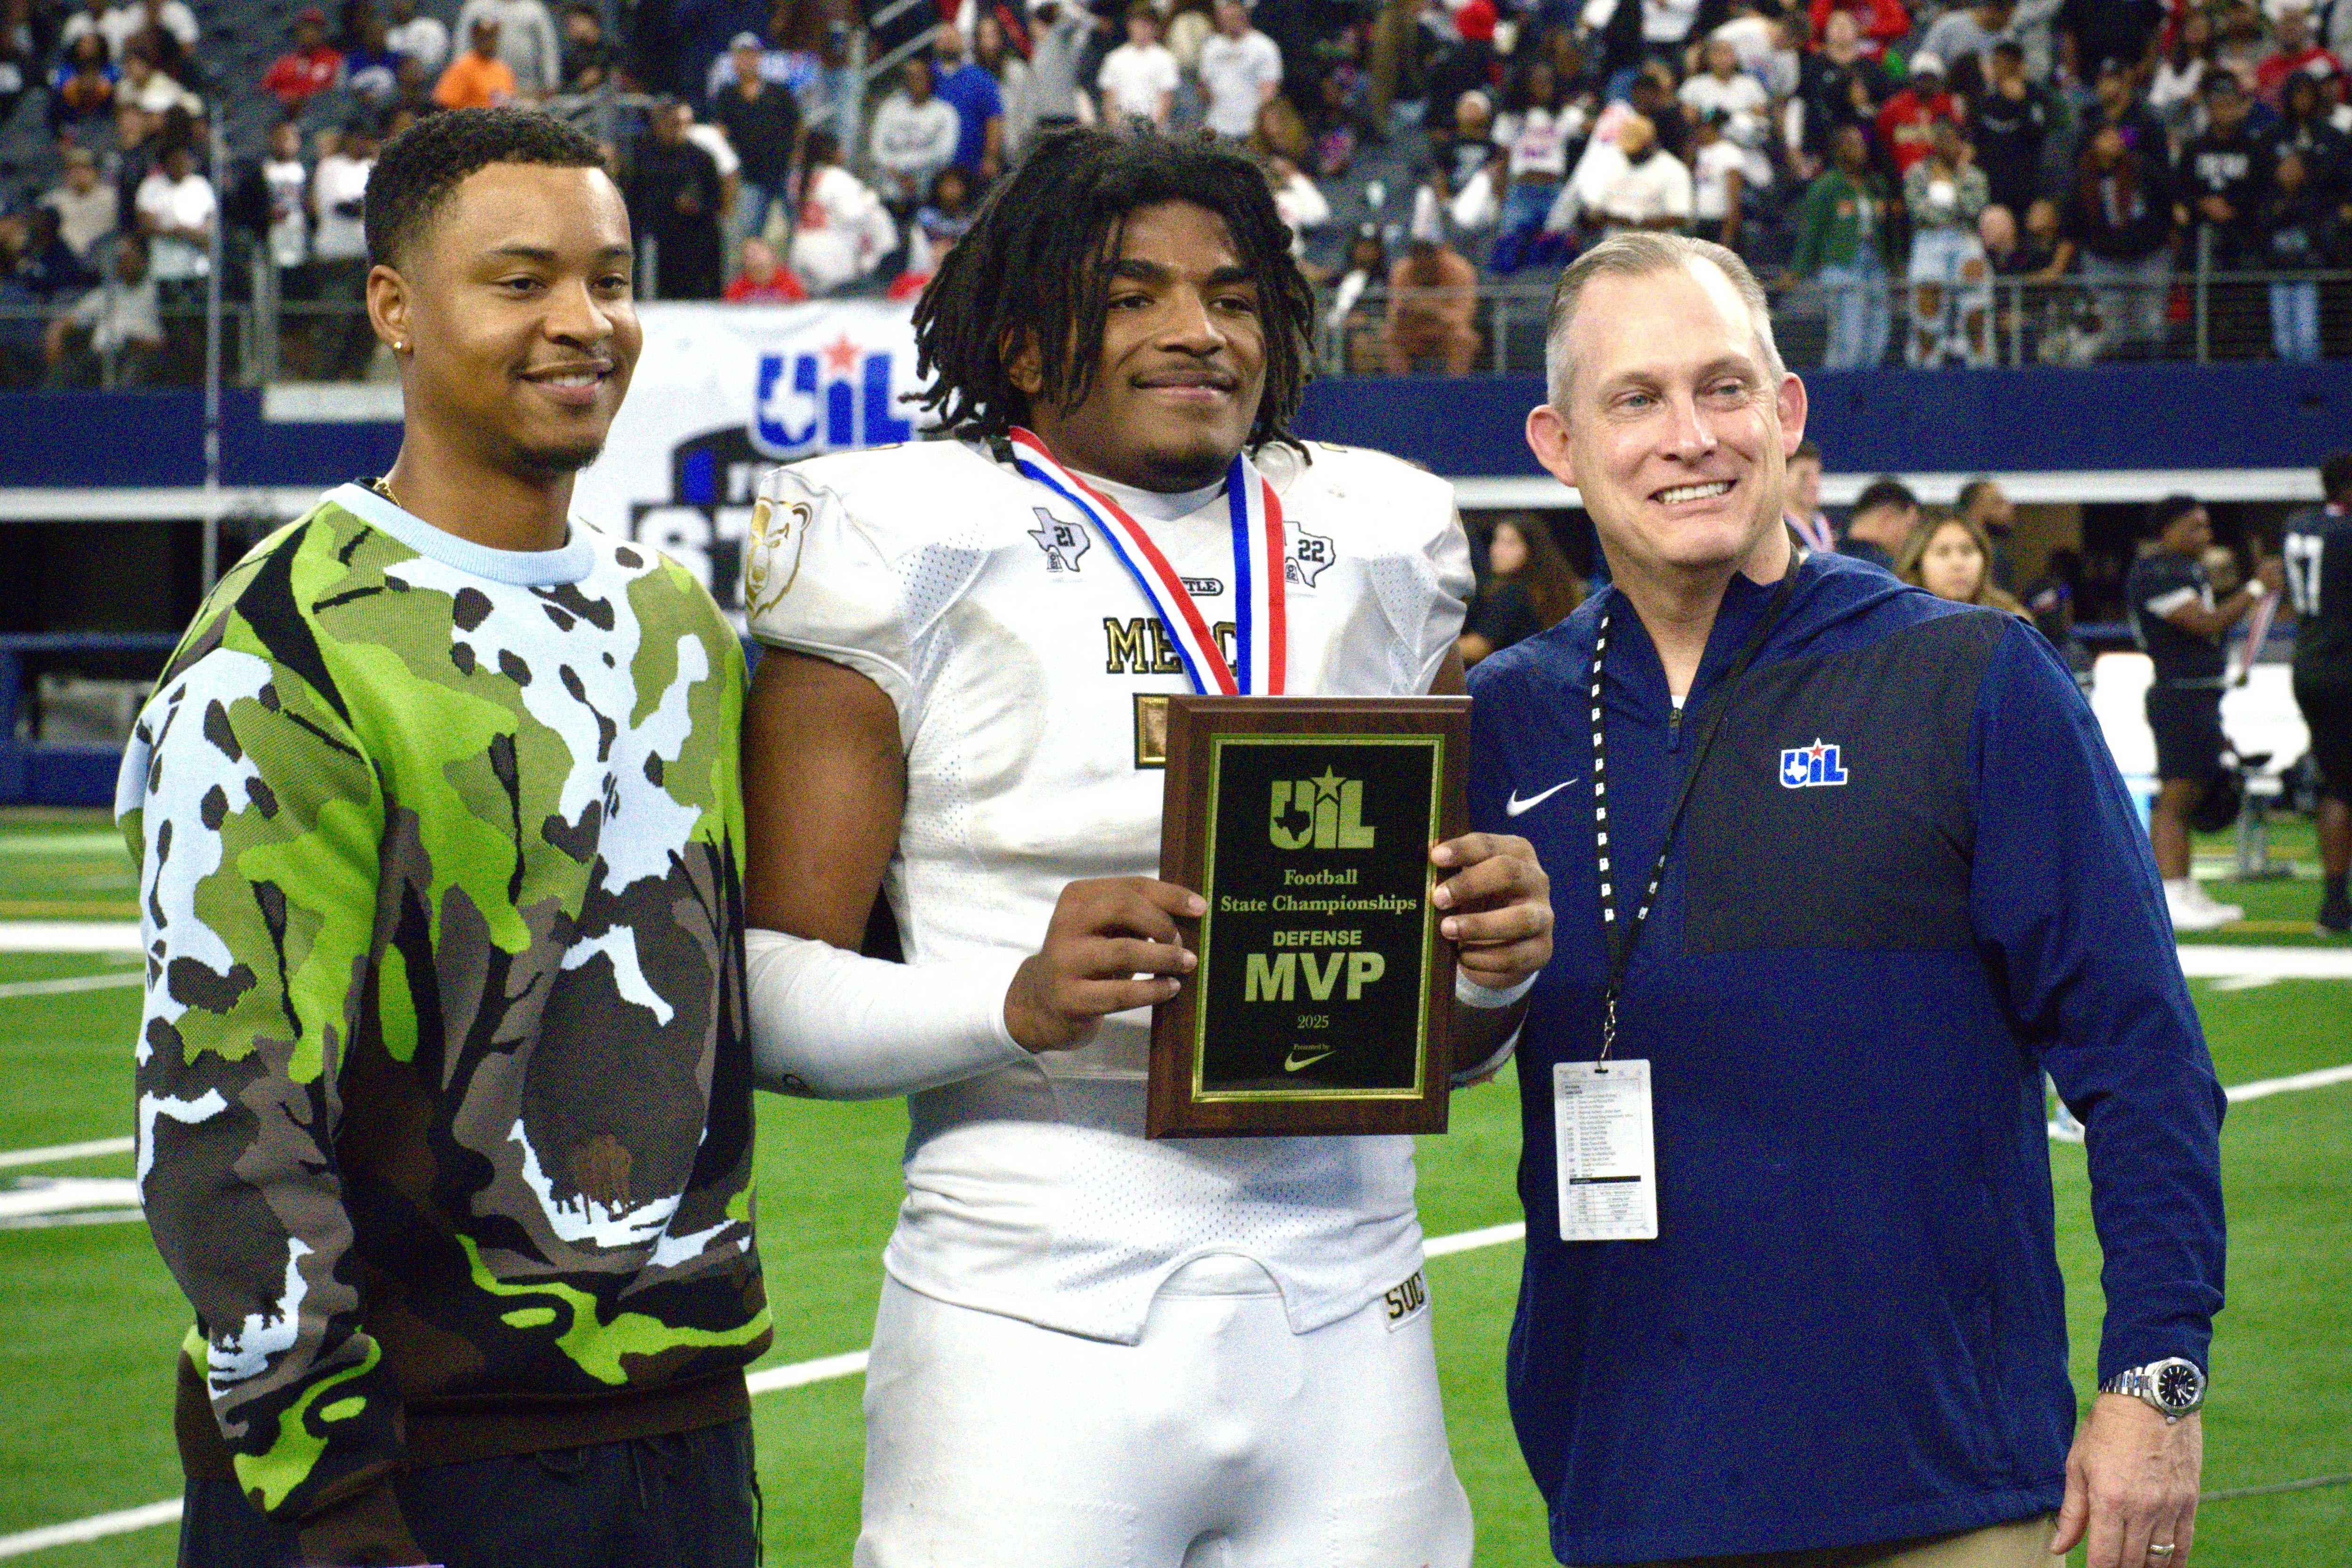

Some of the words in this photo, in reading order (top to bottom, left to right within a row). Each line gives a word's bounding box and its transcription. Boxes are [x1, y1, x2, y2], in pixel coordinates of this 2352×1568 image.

[1054, 526, 1076, 546] 21
[1298, 539, 1325, 563] 22
[1781, 741, 1846, 787] UIL
[1270, 765, 1375, 849] UIL
[1284, 869, 1358, 885] Football
[1221, 896, 1267, 912] State
[1273, 895, 1417, 916] Championships
[1273, 930, 1362, 947] DEFENSE
[1245, 951, 1385, 1002] MVP
[1297, 1015, 1329, 1029] 2025
